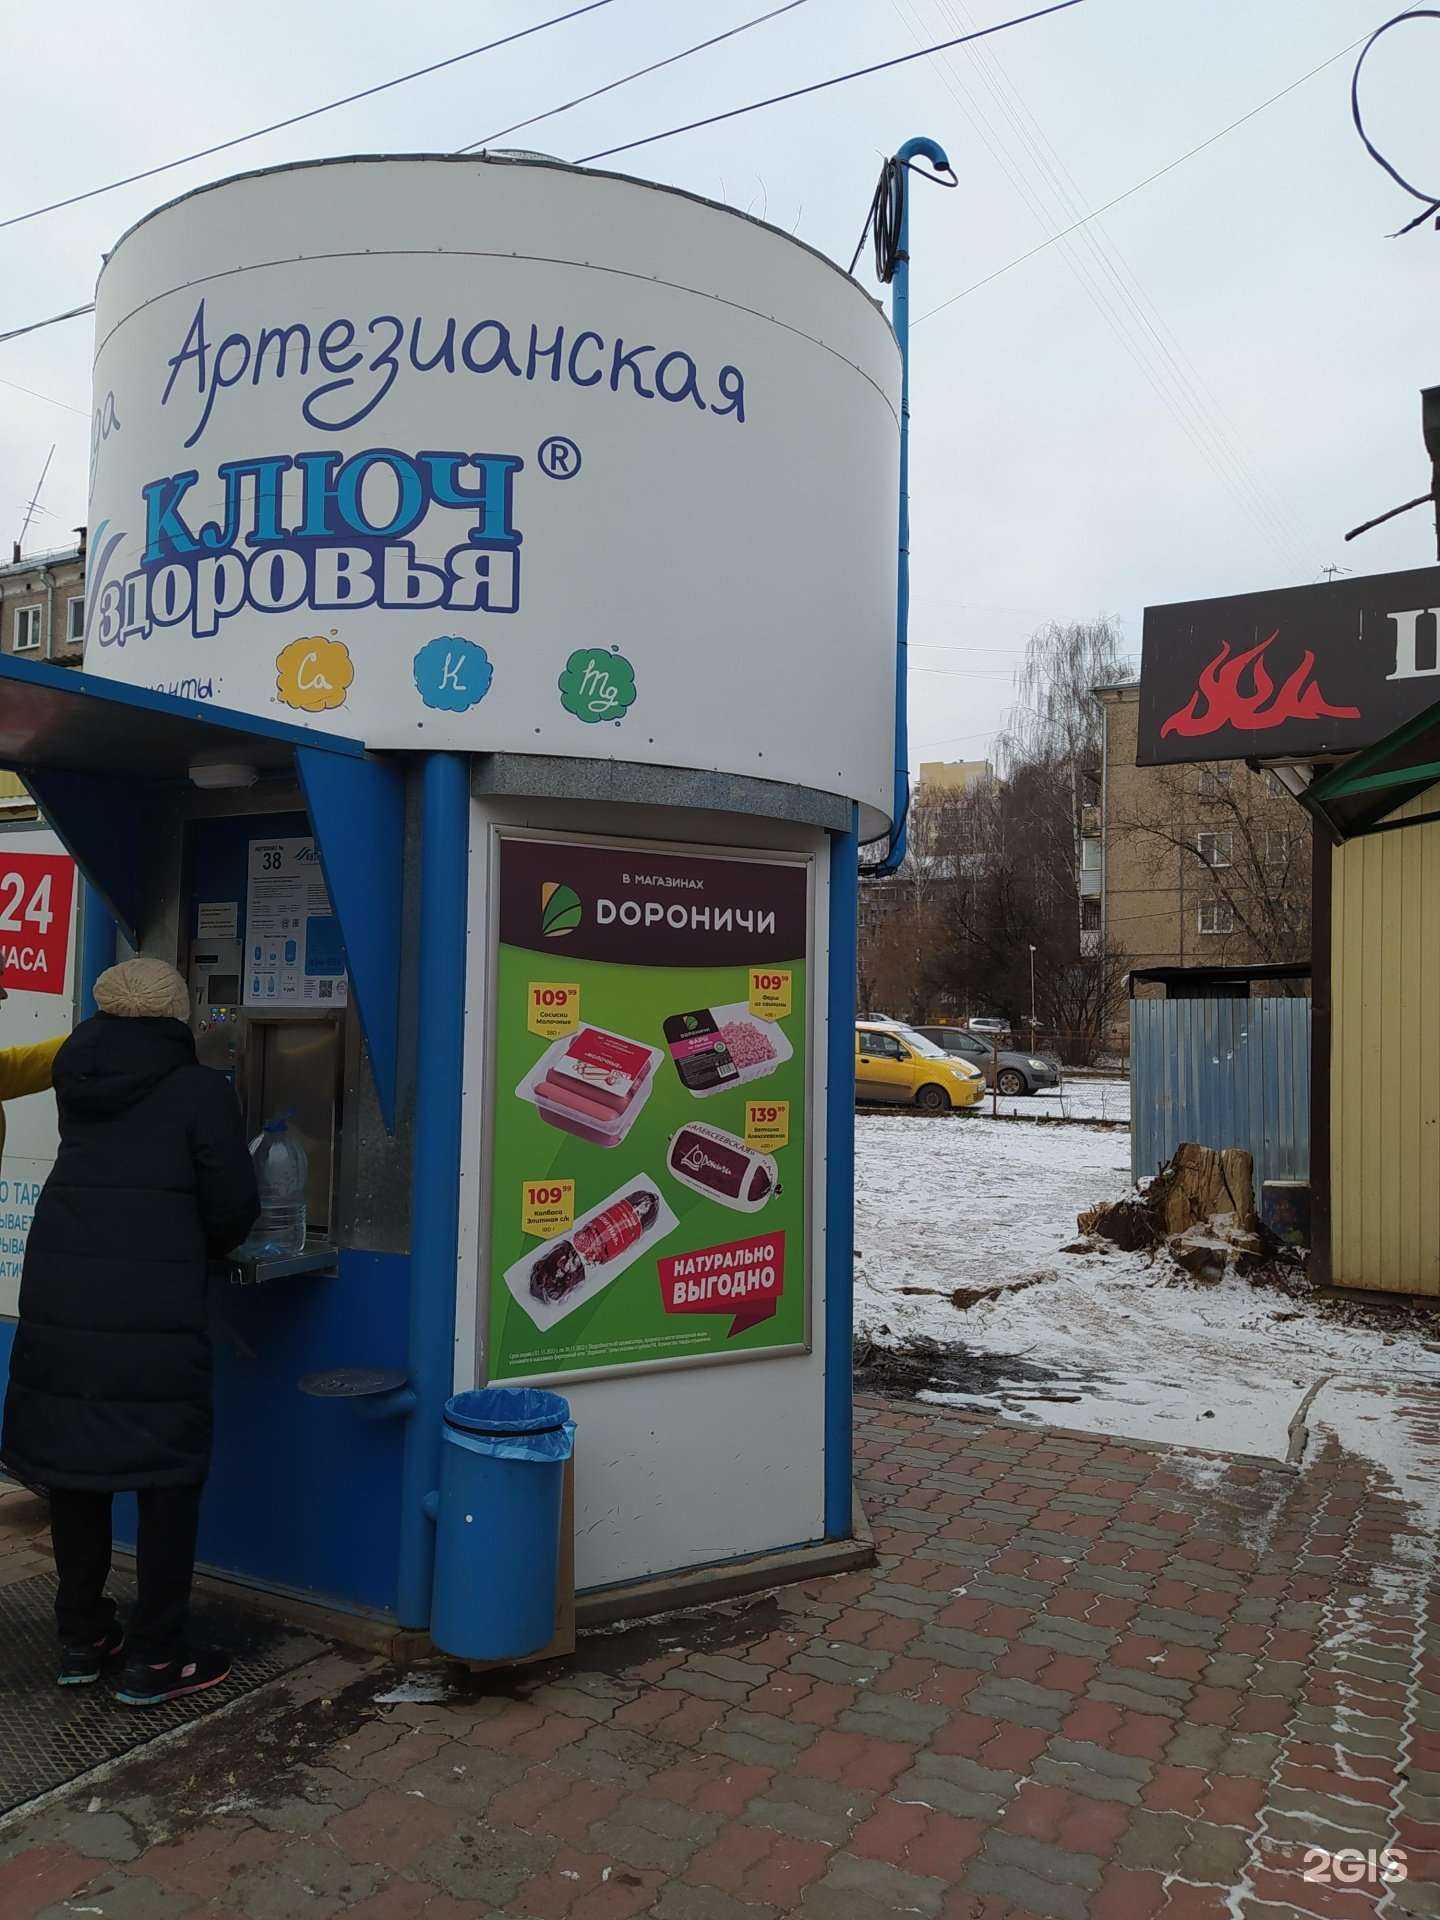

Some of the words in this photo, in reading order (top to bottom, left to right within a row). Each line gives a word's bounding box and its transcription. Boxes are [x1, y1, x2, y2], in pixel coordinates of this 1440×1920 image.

[161, 297, 747, 449] Артезианская
[142, 448, 523, 570] КЛЮЧ
[297, 652, 334, 692] Ca
[438, 652, 468, 692] K
[579, 660, 620, 714] Mg
[263, 852, 282, 870] 38
[622, 873, 631, 884] В
[635, 874, 705, 890] МАГАЗИНАХ
[0, 872, 53, 934] 24
[533, 989, 568, 1006] 109
[753, 975, 781, 990] 109
[750, 1107, 778, 1122] 139
[14, 1182, 43, 1206] ТАР
[528, 1187, 562, 1205] 109
[673, 1244, 775, 1277] НАТУРАЛЬНО
[672, 1266, 776, 1305] ВЫГОДНО
